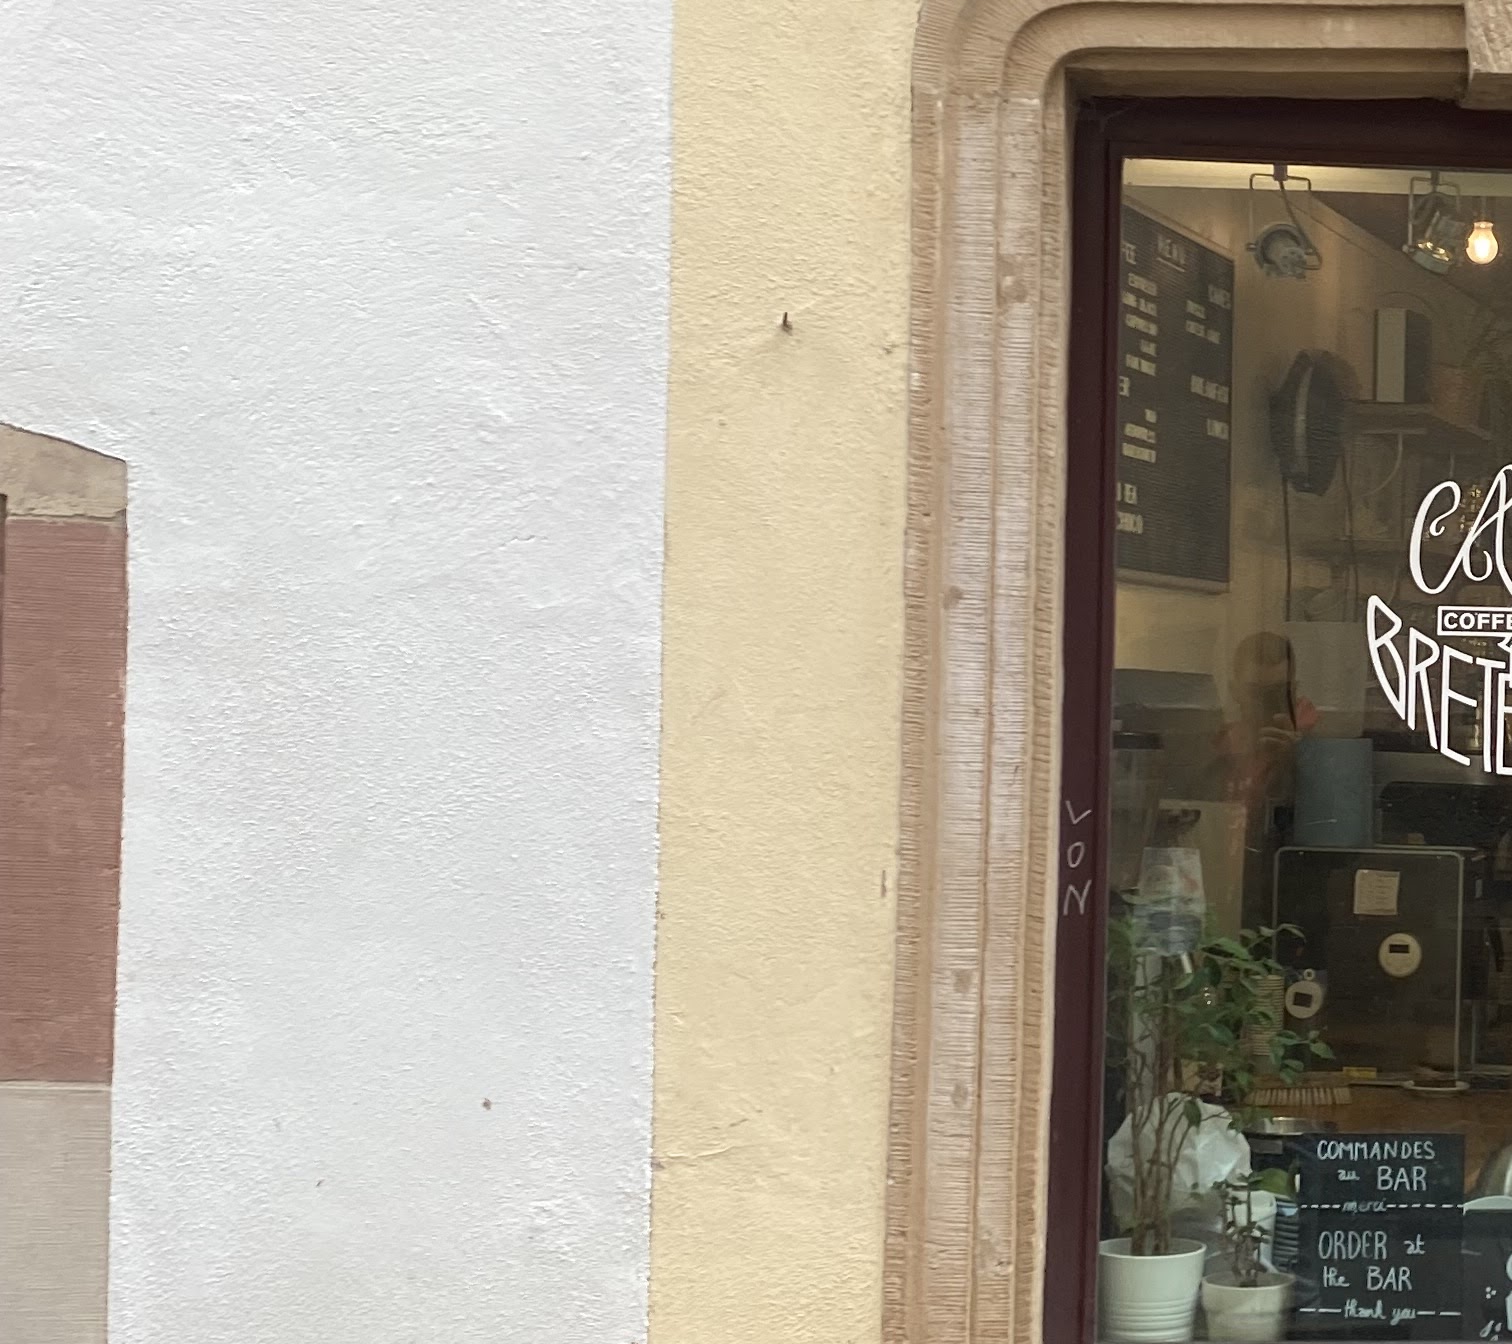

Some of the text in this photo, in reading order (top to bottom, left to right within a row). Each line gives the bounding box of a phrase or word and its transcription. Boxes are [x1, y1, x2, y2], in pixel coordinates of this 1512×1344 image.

[1317, 1140, 1436, 1162] COMMANDES
[1337, 1165, 1427, 1192] au BAR
[1341, 1197, 1388, 1215] merci
[1318, 1230, 1426, 1260] ORDER at
[1322, 1265, 1413, 1292] the BAR
[1344, 1298, 1417, 1326] thank you
